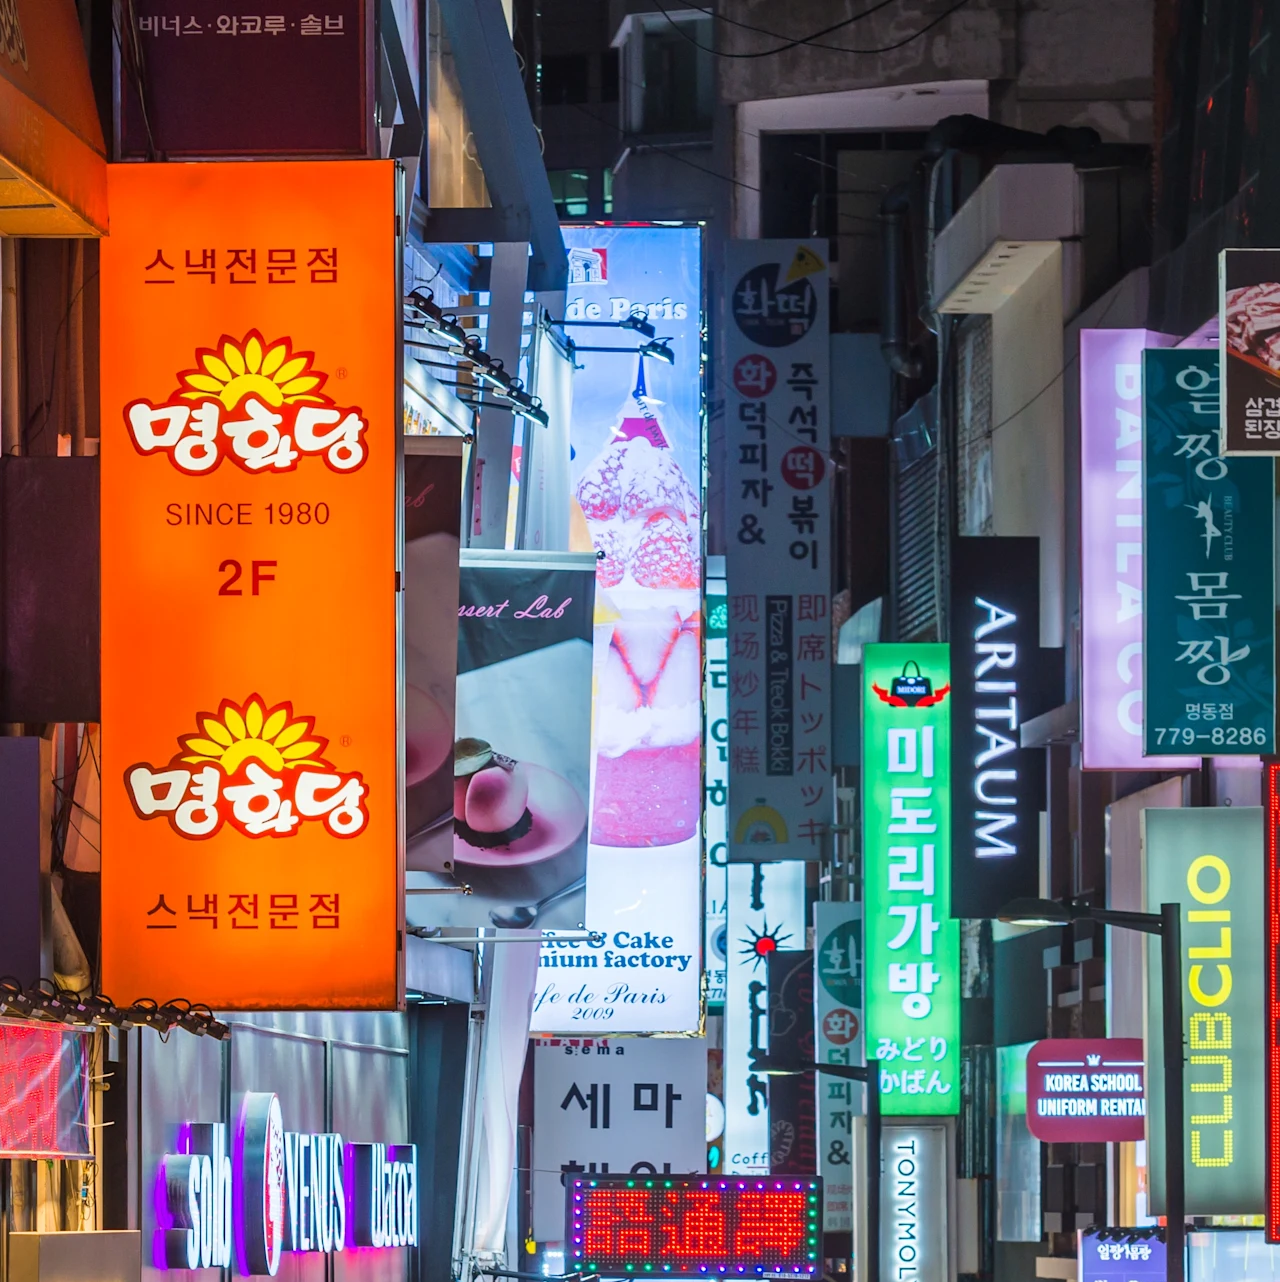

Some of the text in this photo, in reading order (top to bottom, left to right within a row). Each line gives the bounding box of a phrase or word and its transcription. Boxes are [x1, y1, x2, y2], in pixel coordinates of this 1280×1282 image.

[139, 14, 344, 37] 비너스 와코루 솔브
[144, 247, 340, 285] 스낵전문점
[567, 295, 688, 322] de Paris
[127, 398, 365, 472] 명화당
[166, 502, 331, 526] SINCE 1980
[217, 559, 278, 597] 2F
[457, 602, 510, 620] ssert
[1175, 571, 1251, 686] 몸짱
[1185, 702, 1234, 722] 명동점
[974, 596, 1018, 860] ARITAUM
[1154, 726, 1267, 747] 779-8286
[129, 762, 365, 836] 명화당
[886, 725, 942, 1020] 미도리가방
[146, 893, 341, 930] 스낵전문점
[613, 930, 674, 950] Cake
[603, 950, 693, 972] factory
[603, 982, 675, 1005] Paris
[571, 1007, 615, 1021] 2009
[876, 1036, 949, 1062] みどり
[880, 1069, 951, 1096] かばん
[1045, 1074, 1089, 1092] KOREA
[560, 1082, 683, 1129] 세마
[1038, 1098, 1098, 1117] UNIFORM
[283, 1132, 346, 1253] VENUS
